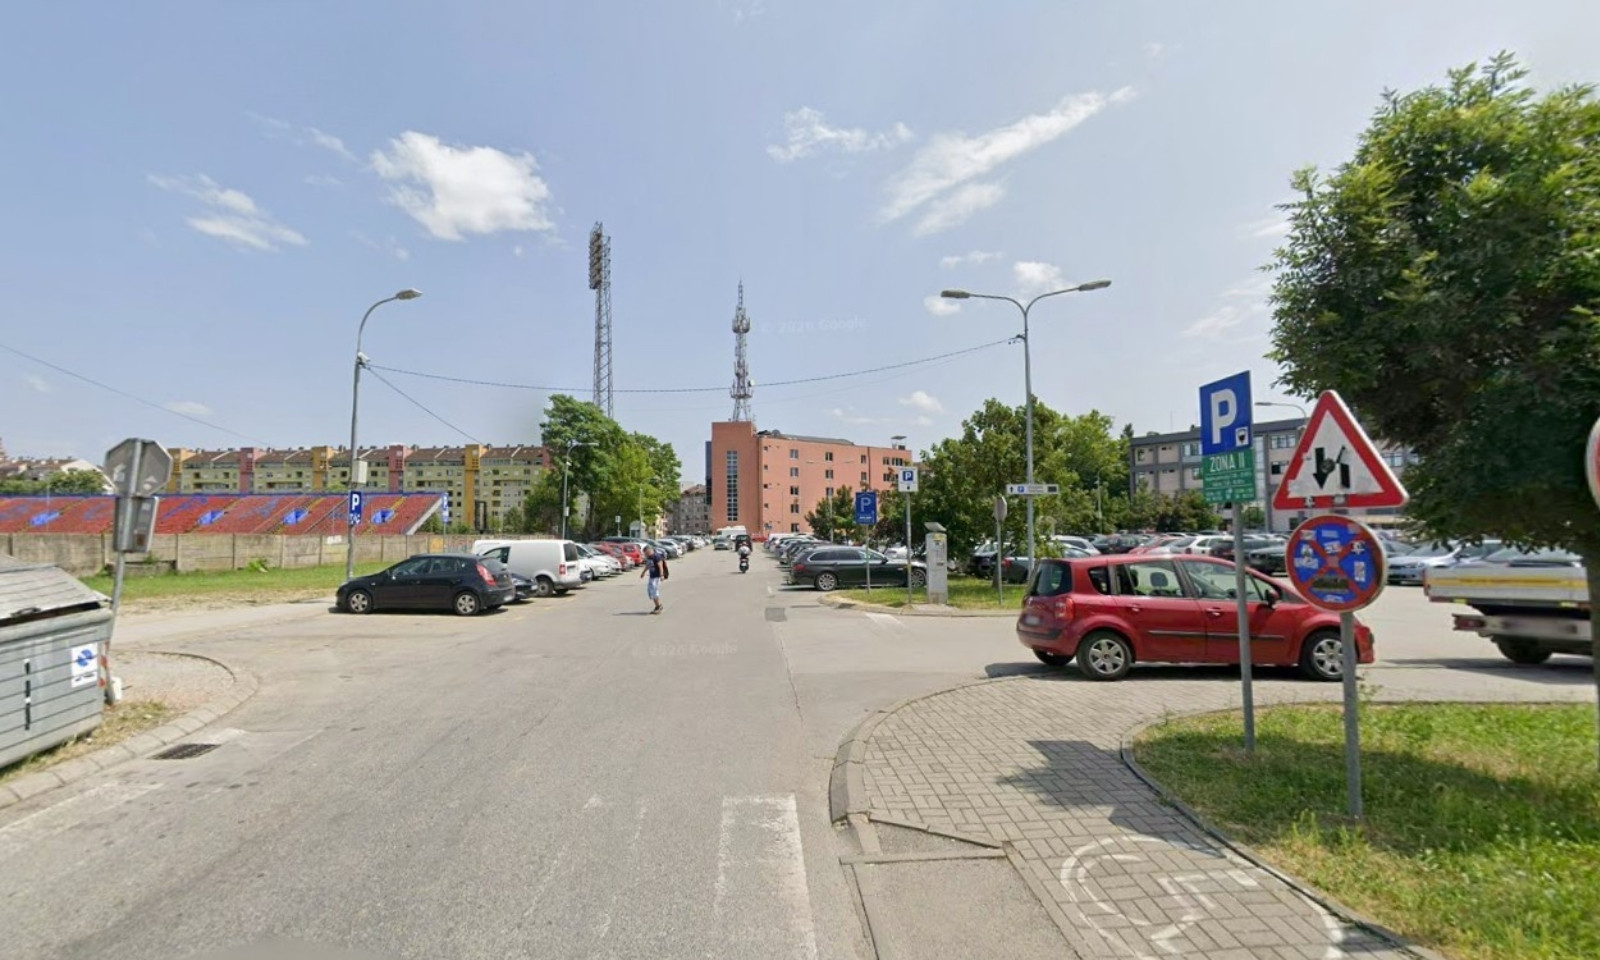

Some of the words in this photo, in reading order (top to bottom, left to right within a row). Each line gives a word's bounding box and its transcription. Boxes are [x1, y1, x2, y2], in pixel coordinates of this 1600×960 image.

[1211, 389, 1237, 444] P
[1210, 454, 1236, 472] ZONA
[352, 493, 360, 511] P
[861, 497, 872, 512] P
